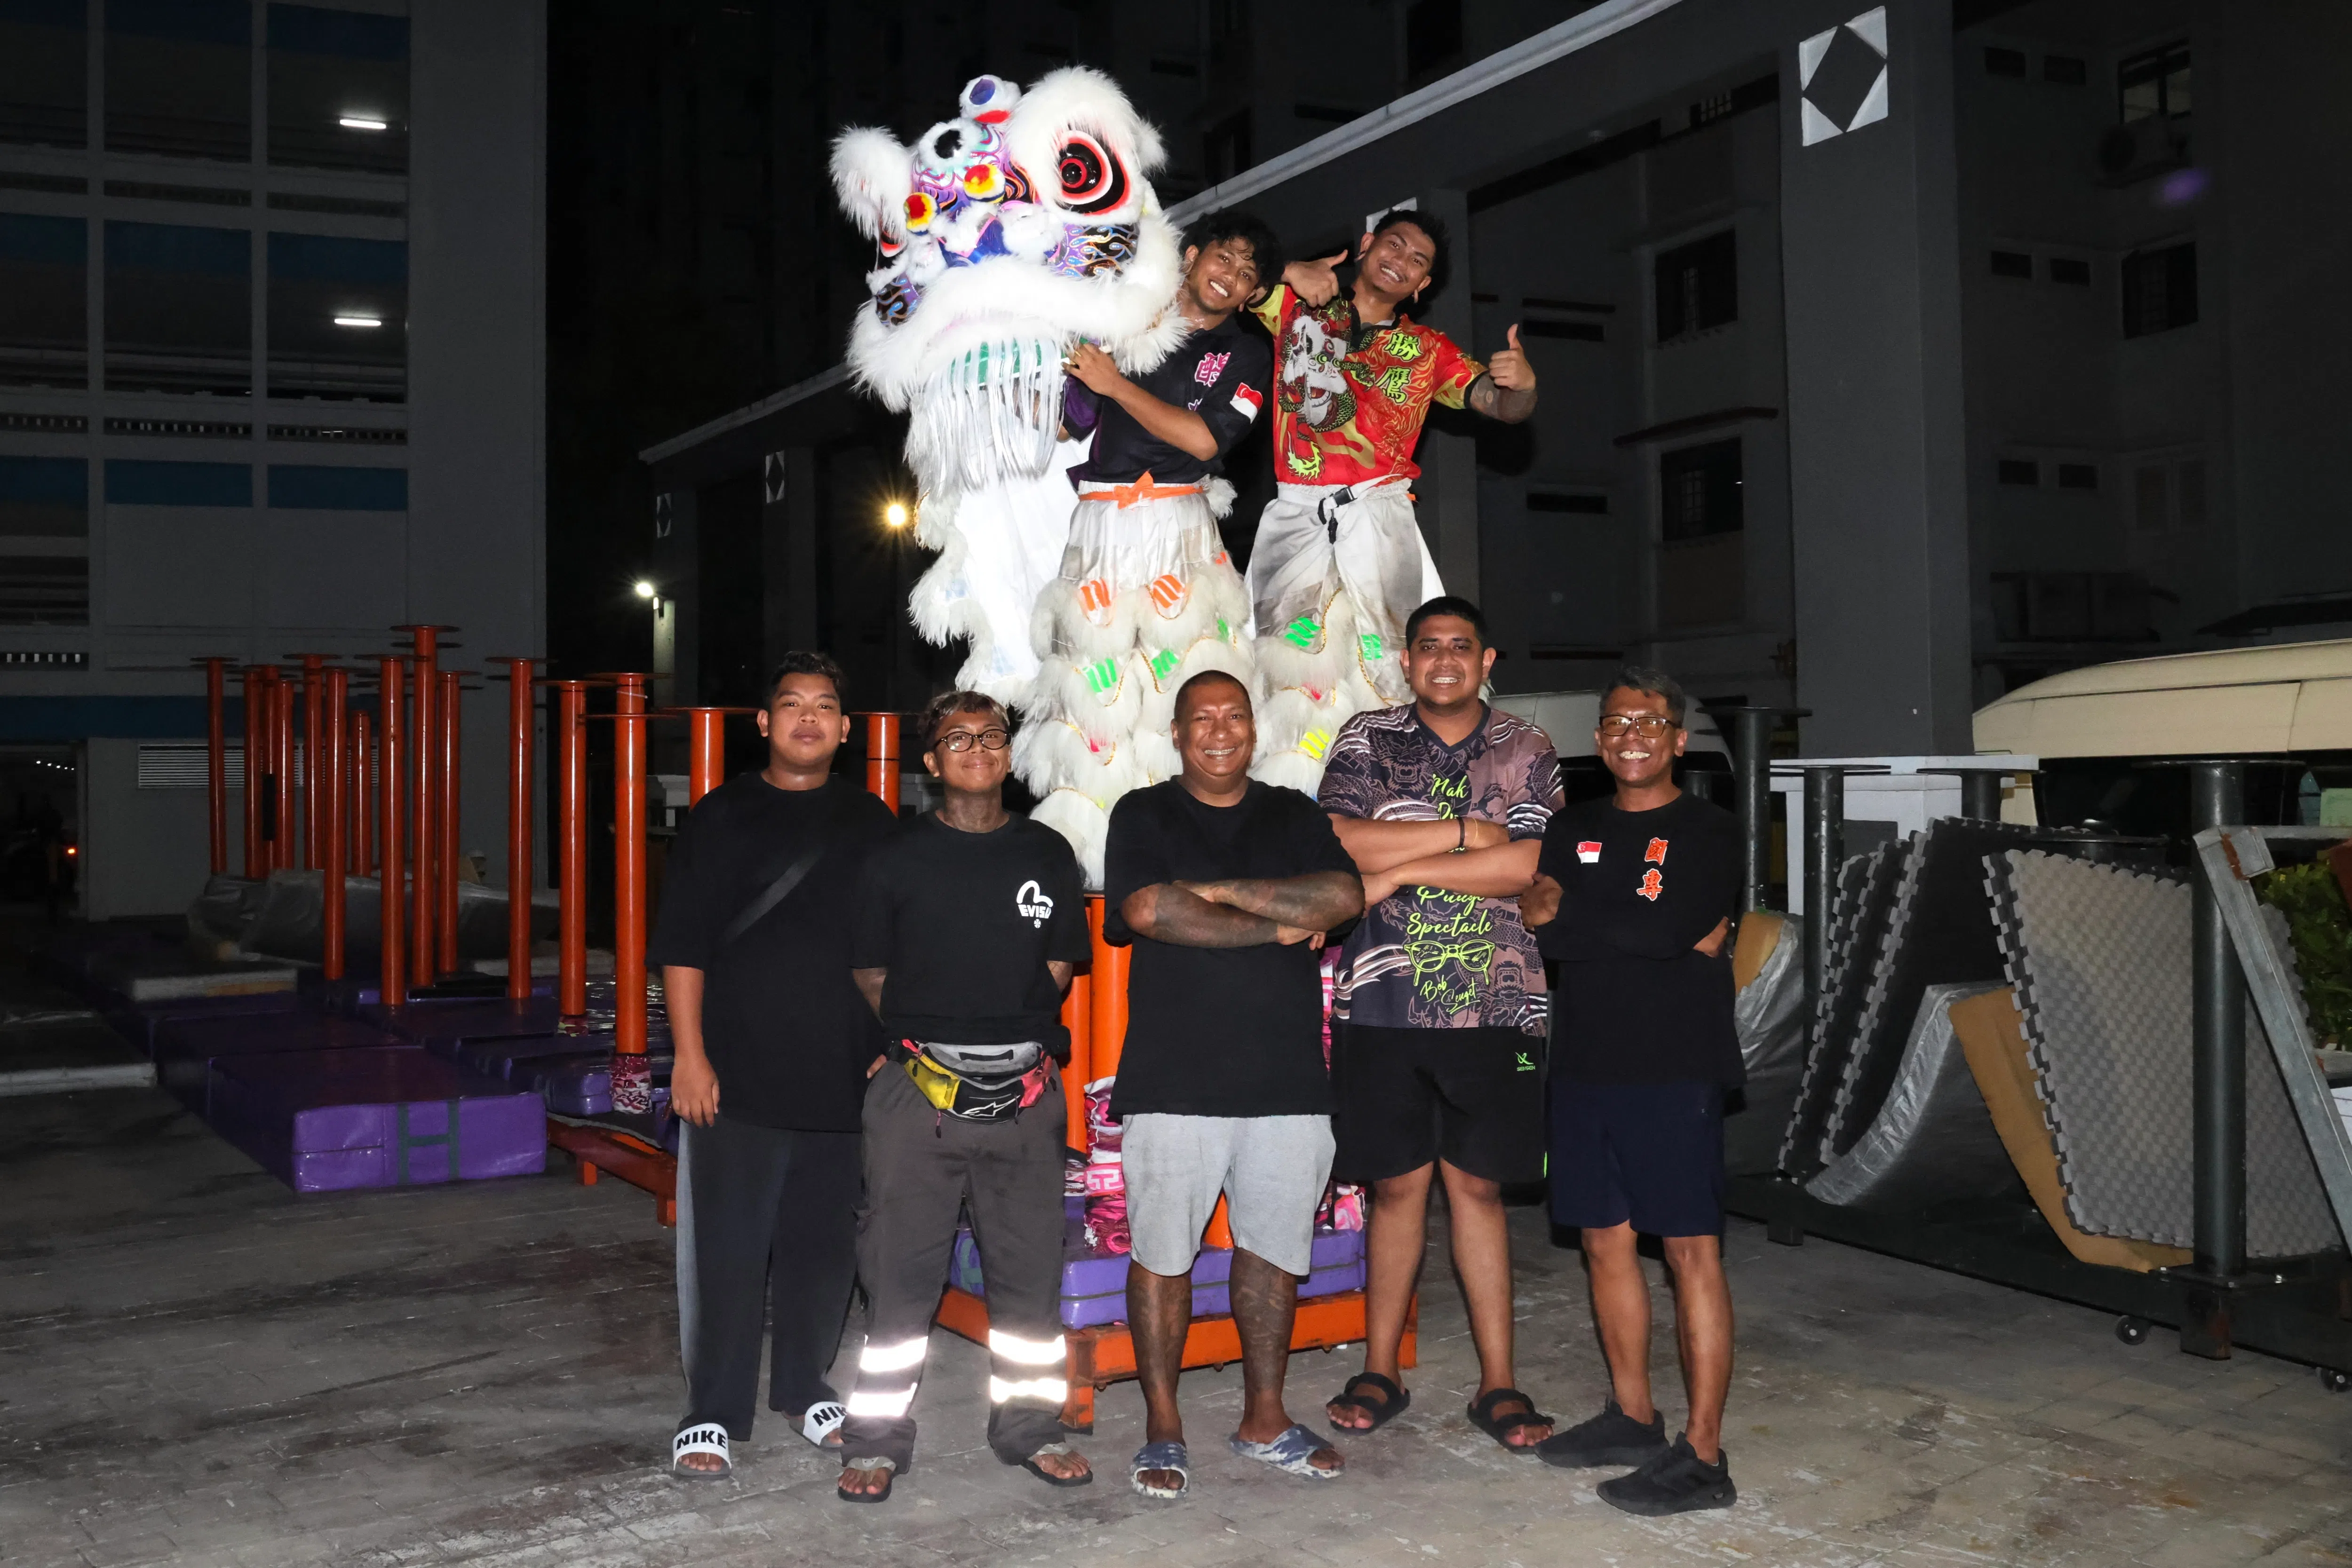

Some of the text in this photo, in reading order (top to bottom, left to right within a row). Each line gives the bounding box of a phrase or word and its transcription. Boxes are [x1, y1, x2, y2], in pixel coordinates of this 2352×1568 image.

[1018, 904, 1052, 919] EVISU
[1407, 909, 1493, 940] Spectacle
[1420, 974, 1447, 1002] Bob
[812, 1406, 847, 1426] NIK
[676, 1430, 726, 1450] NIKE
